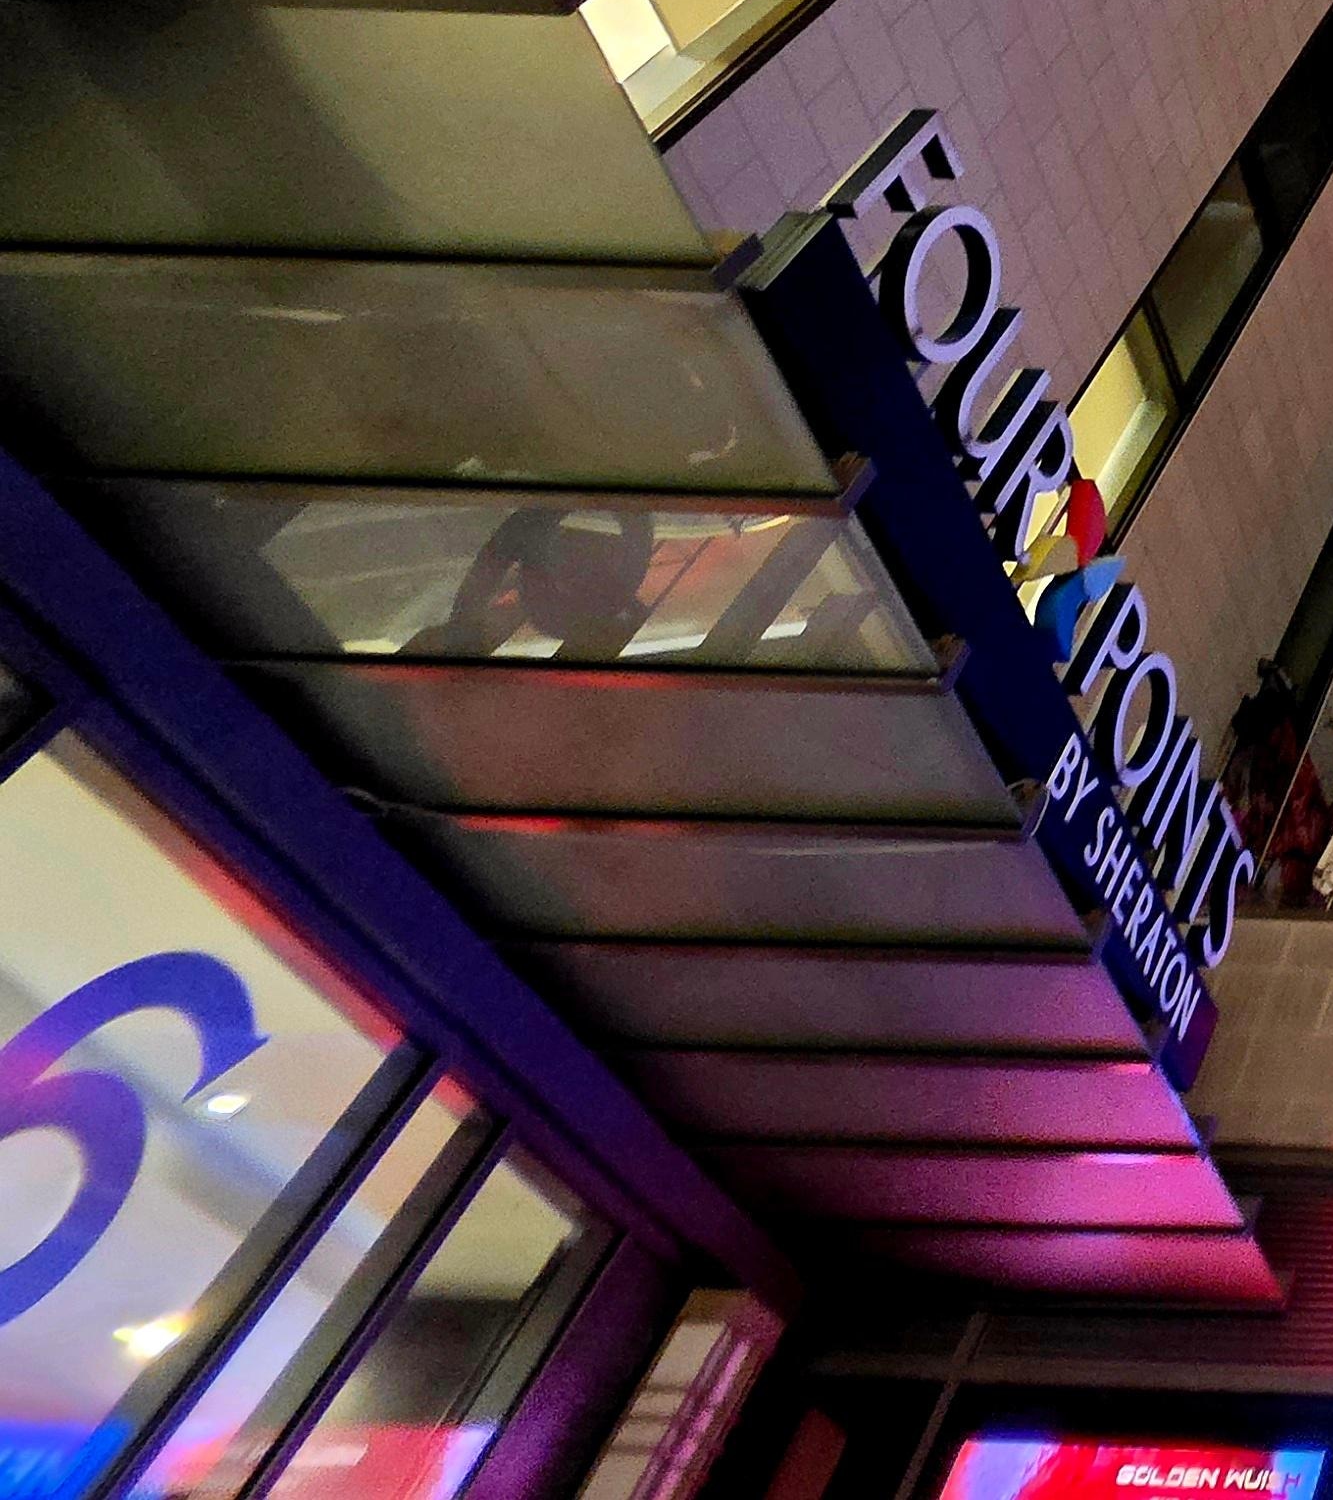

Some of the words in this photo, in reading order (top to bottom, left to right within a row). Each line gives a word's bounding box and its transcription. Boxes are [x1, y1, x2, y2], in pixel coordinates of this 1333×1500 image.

[850, 112, 1074, 560] FOUR
[1079, 586, 1255, 968] POINTS
[1046, 732, 1100, 822] BY
[1083, 807, 1201, 1041] SHERATON
[1116, 1464, 1221, 1489] GOLDEN
